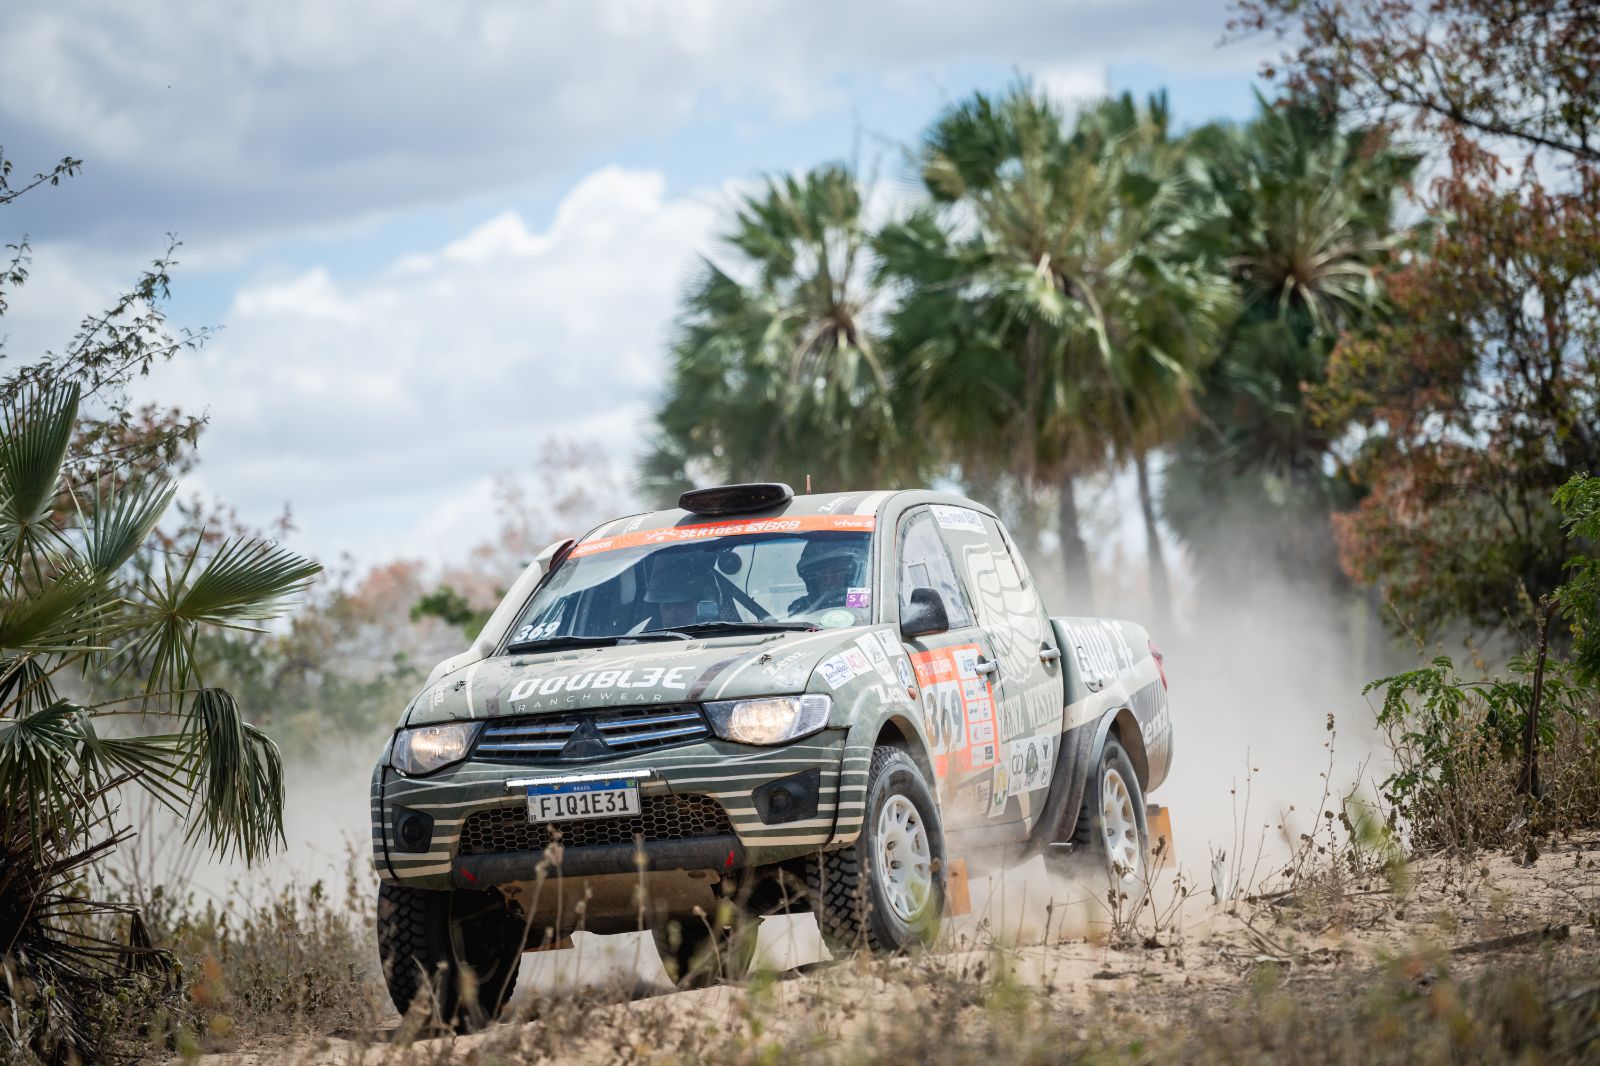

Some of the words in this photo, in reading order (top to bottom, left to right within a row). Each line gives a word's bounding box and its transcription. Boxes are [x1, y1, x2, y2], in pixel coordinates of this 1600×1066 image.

[764, 520, 801, 531] BRB
[834, 520, 862, 528] vivo
[514, 621, 561, 641] 369
[518, 692, 662, 712] RANCHWEAR
[925, 688, 963, 748] 369
[540, 791, 629, 818] FIQ1E31
